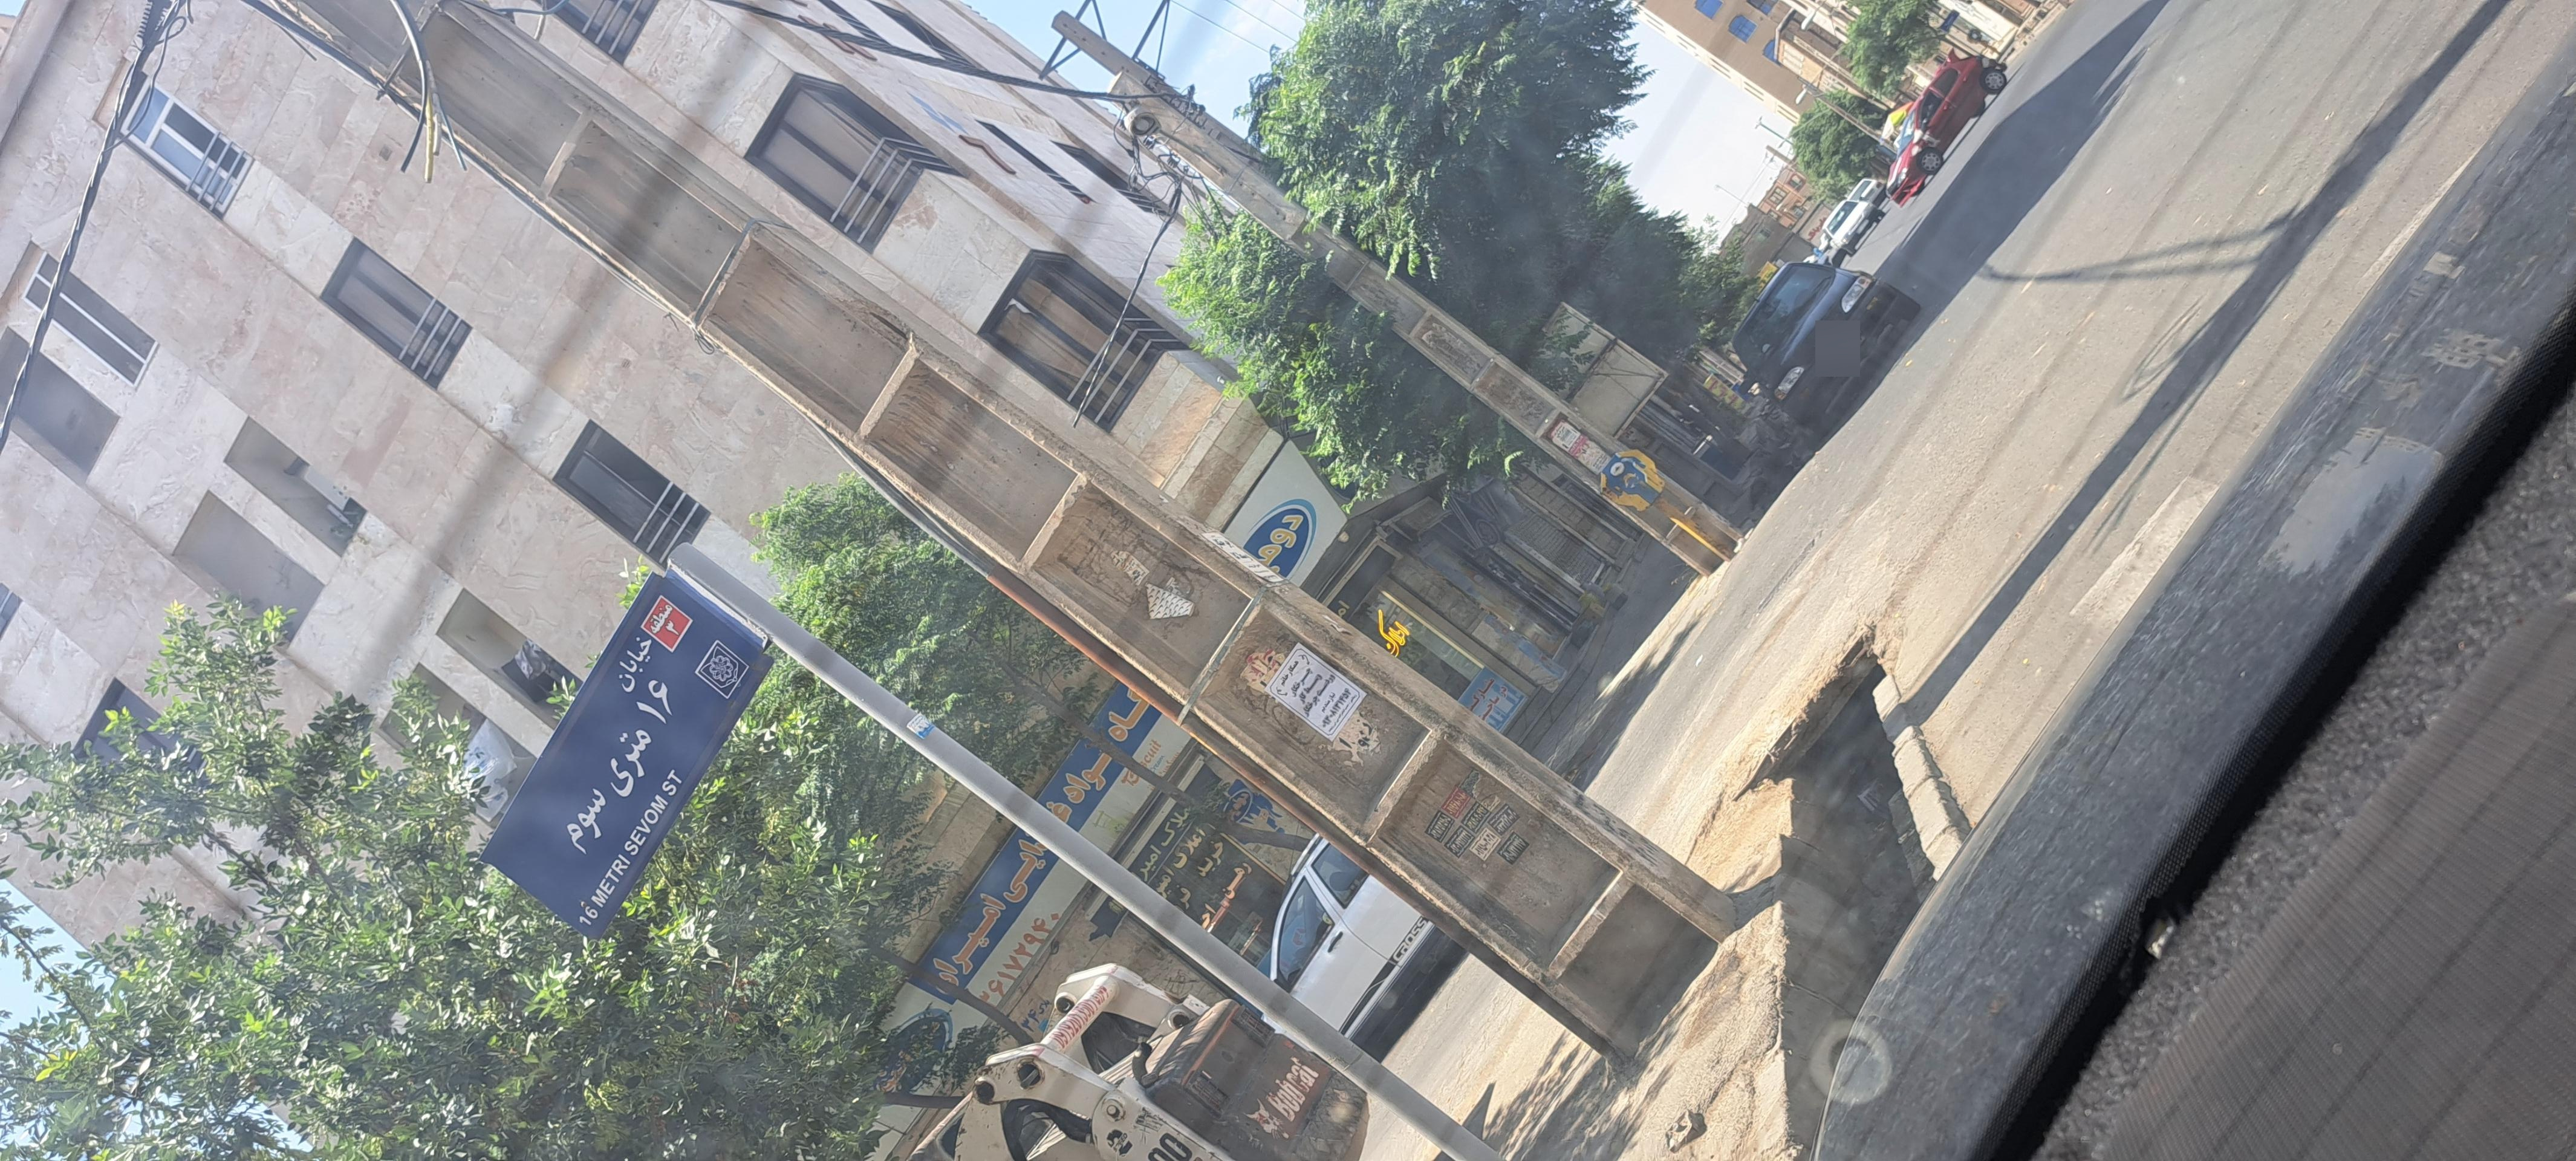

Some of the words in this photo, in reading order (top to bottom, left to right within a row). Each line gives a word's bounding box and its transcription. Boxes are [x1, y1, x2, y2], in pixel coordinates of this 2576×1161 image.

[651, 603, 673, 635] منطقه
[666, 620, 680, 635] ۳
[619, 636, 652, 692] خیابان
[636, 680, 673, 723] ۱۶
[610, 729, 652, 798] متری
[1064, 753, 1115, 803] واد
[566, 787, 607, 855] سوم
[1160, 806, 1192, 846] ملاک
[579, 908, 598, 927] 16
[593, 854, 631, 909] METRI
[625, 793, 668, 856] SEVOM
[662, 769, 685, 800] ST
[1005, 802, 1073, 902] غایی
[1392, 916, 1428, 961] CROSS
